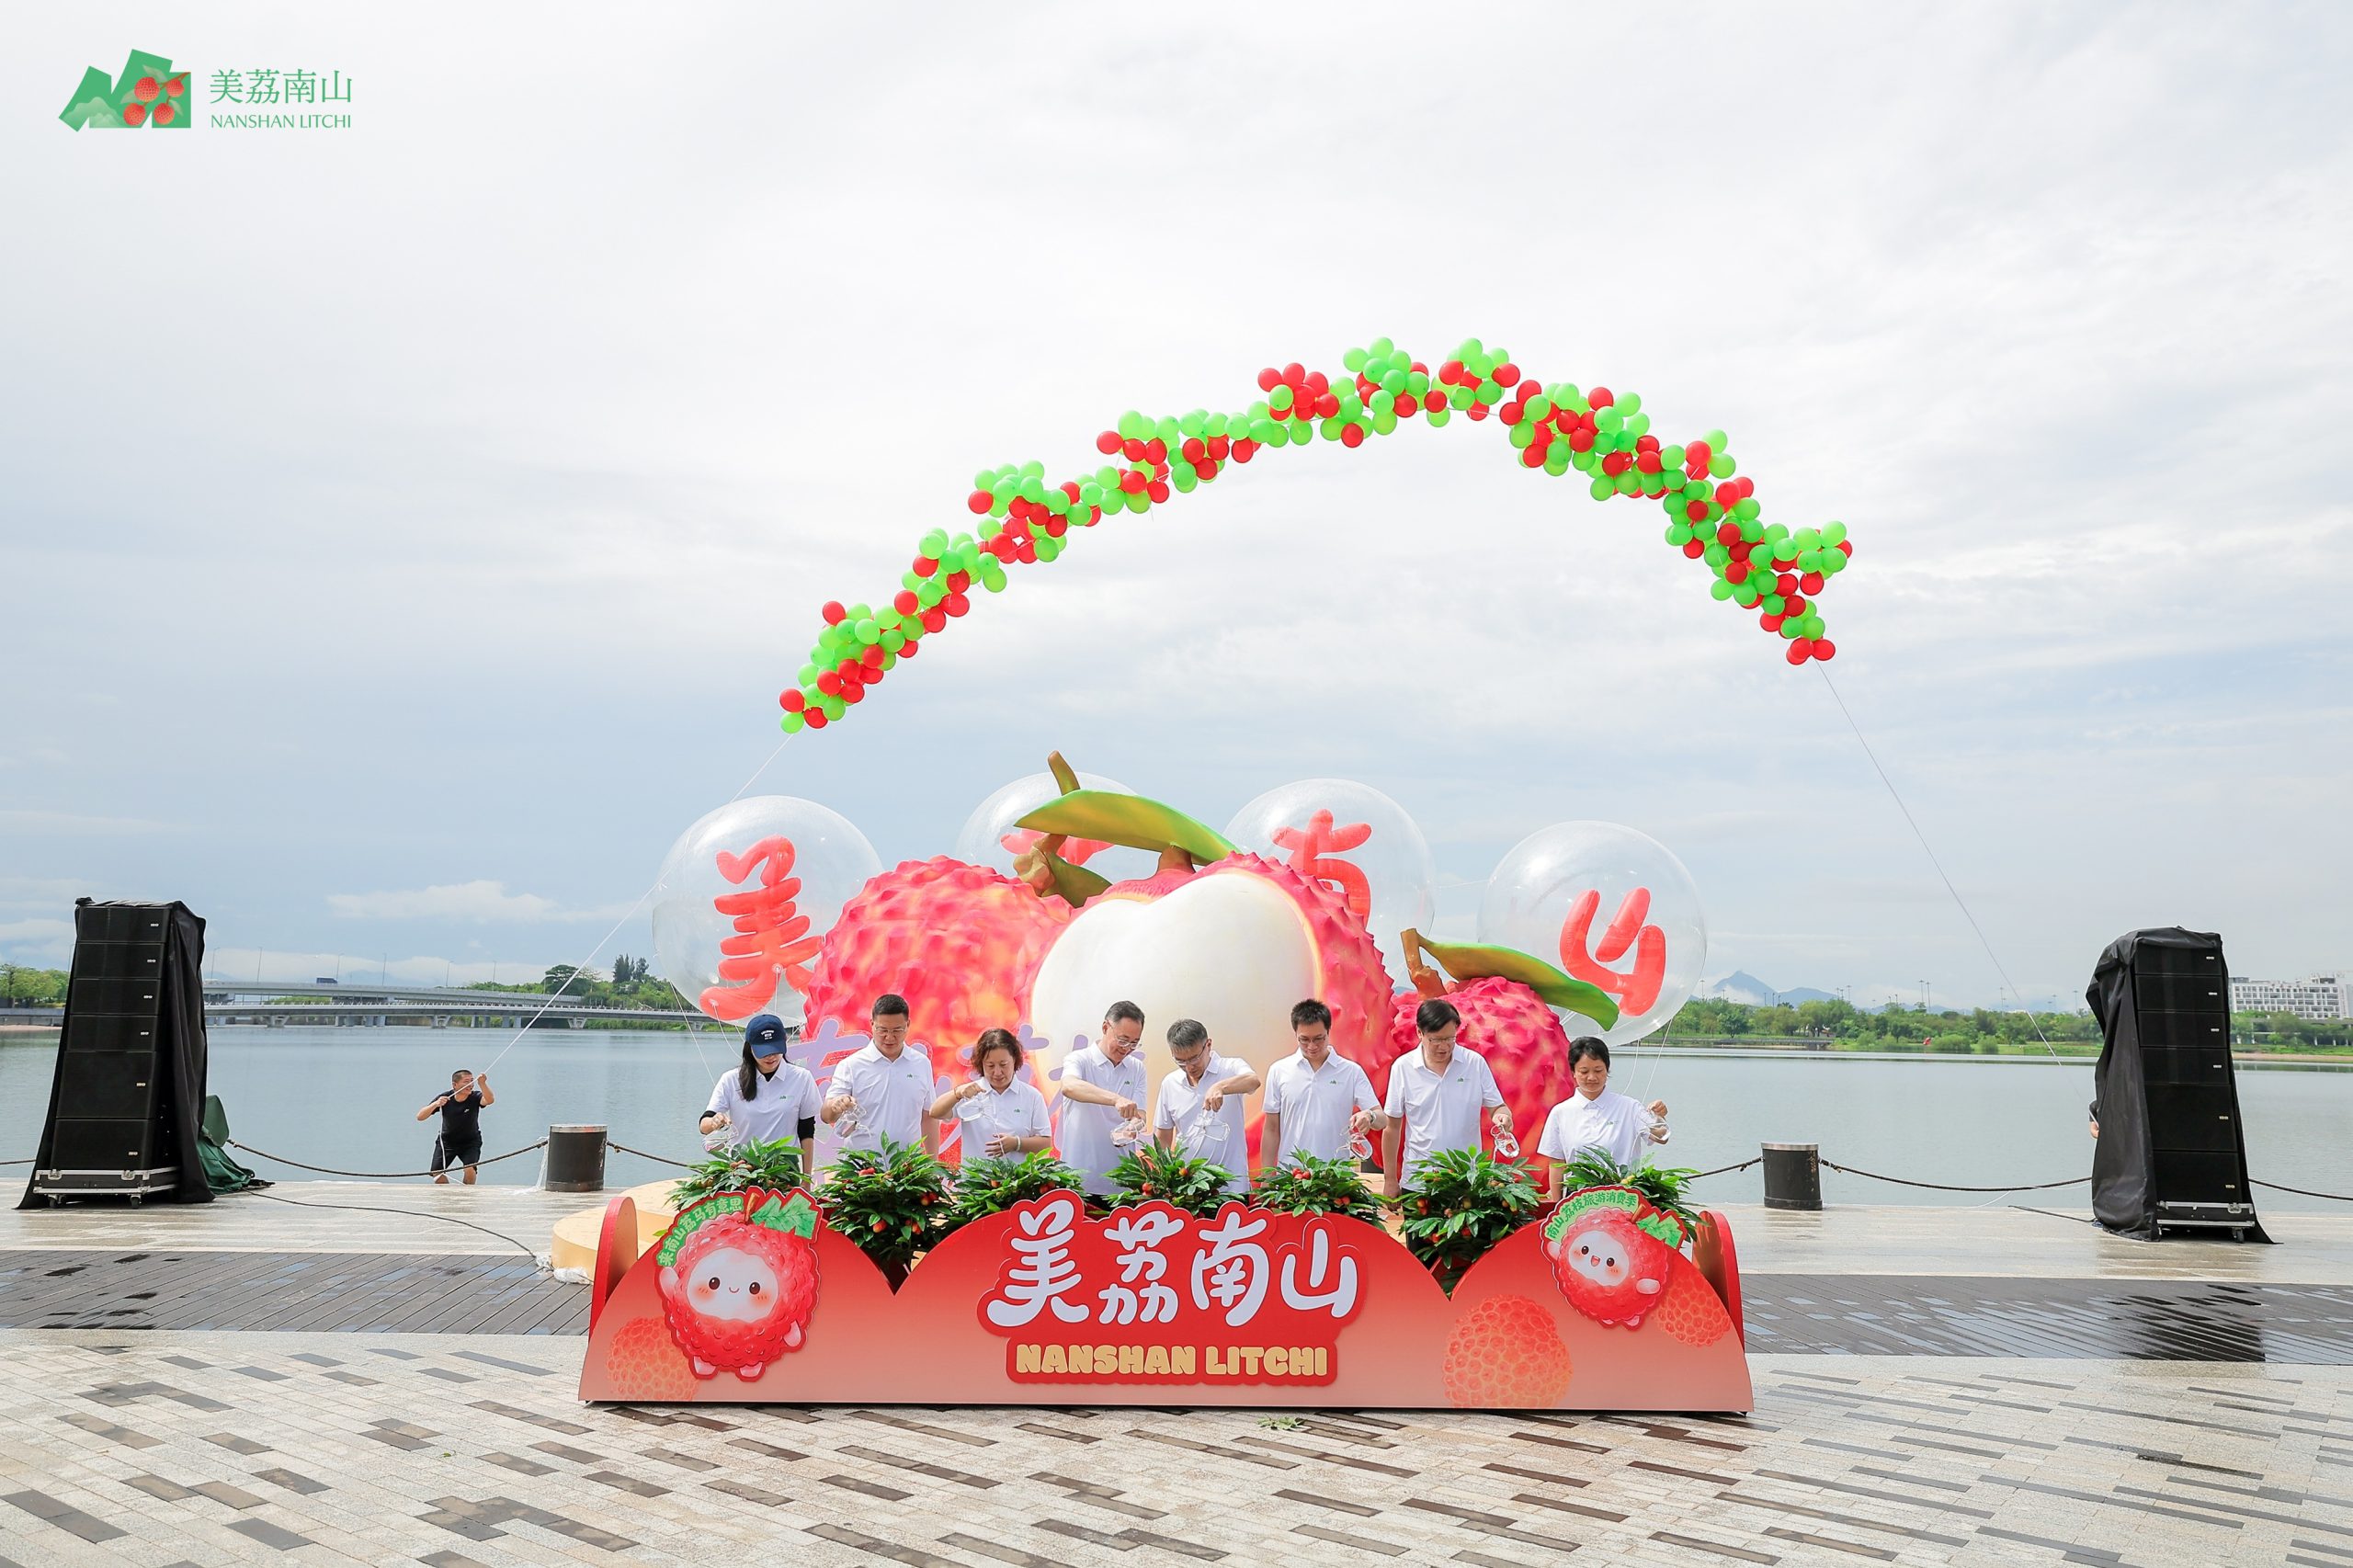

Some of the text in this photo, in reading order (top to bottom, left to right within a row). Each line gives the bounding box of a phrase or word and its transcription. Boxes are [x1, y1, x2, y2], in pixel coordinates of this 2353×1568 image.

[699, 834, 825, 1021] 美
[1559, 886, 1666, 1017] 山
[986, 1199, 1358, 1328] 美荔南山
[1546, 1191, 1638, 1239] 南山荔枝旅游消费季
[1016, 1344, 1328, 1377] NANSHAN LITCHI
